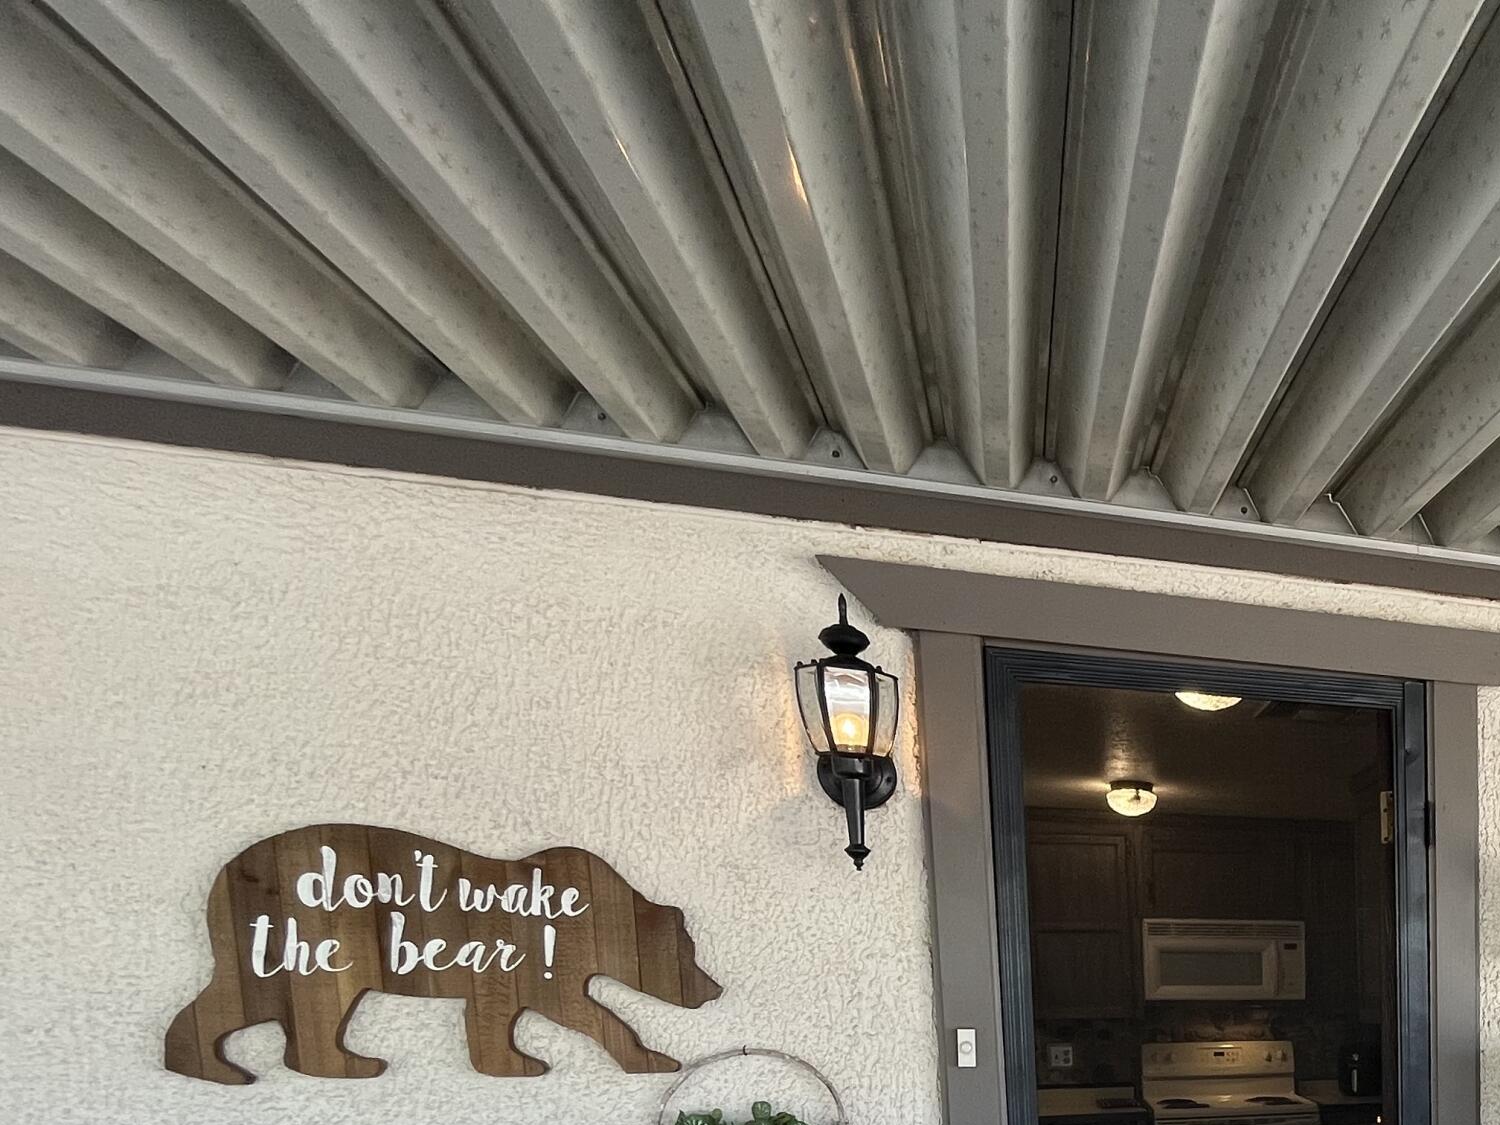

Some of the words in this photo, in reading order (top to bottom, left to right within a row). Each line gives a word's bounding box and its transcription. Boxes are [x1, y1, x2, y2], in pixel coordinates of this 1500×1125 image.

[296, 845, 448, 913] don't
[458, 867, 590, 919] wake
[249, 914, 353, 978] the
